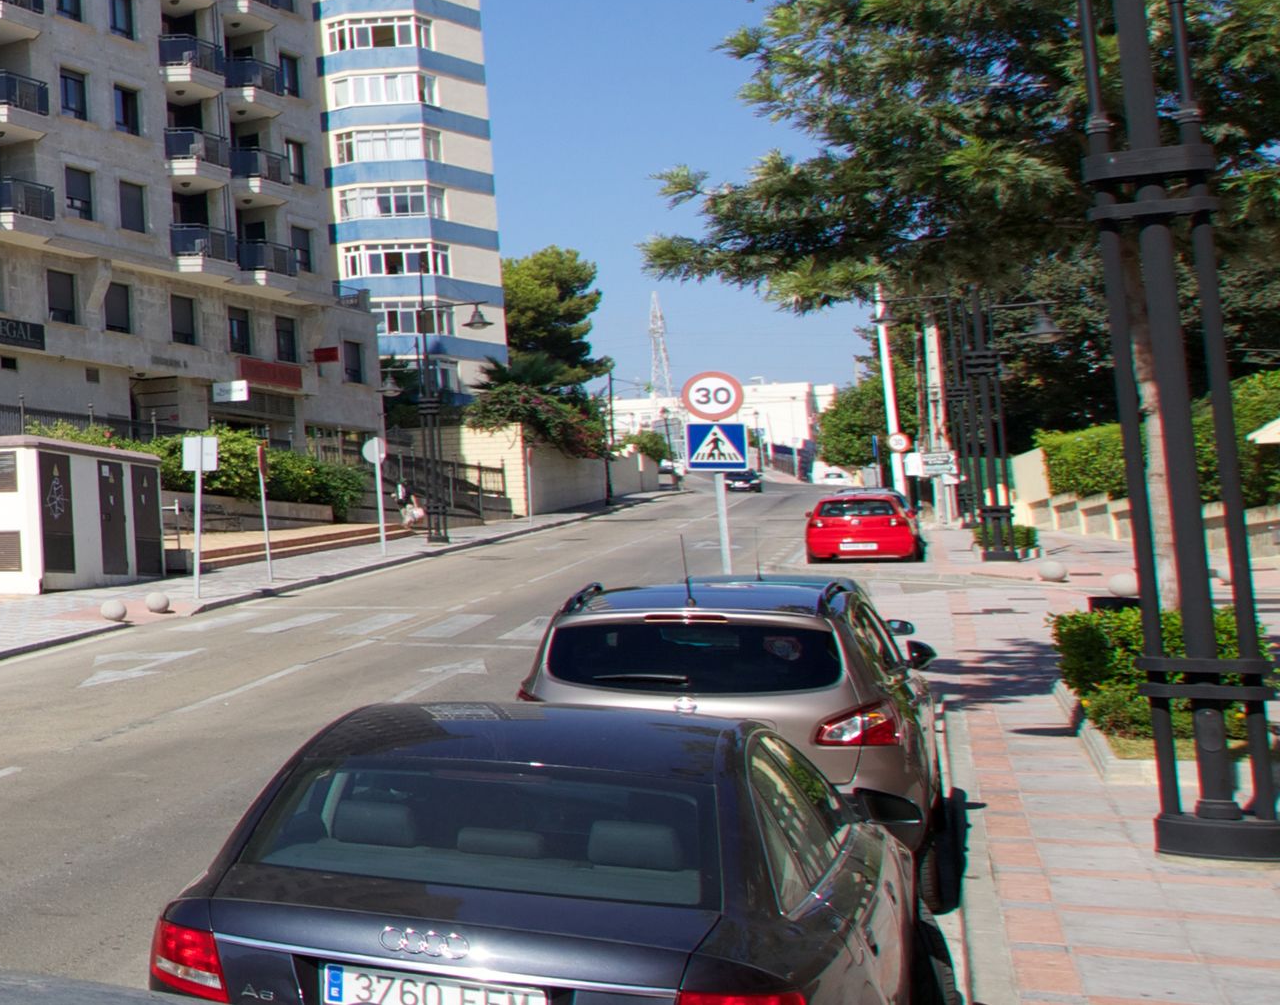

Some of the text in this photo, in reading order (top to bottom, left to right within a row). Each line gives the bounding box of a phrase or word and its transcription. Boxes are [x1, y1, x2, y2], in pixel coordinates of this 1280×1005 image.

[695, 387, 731, 405] 30
[241, 983, 275, 1002] A6
[354, 973, 443, 1005] 3760
